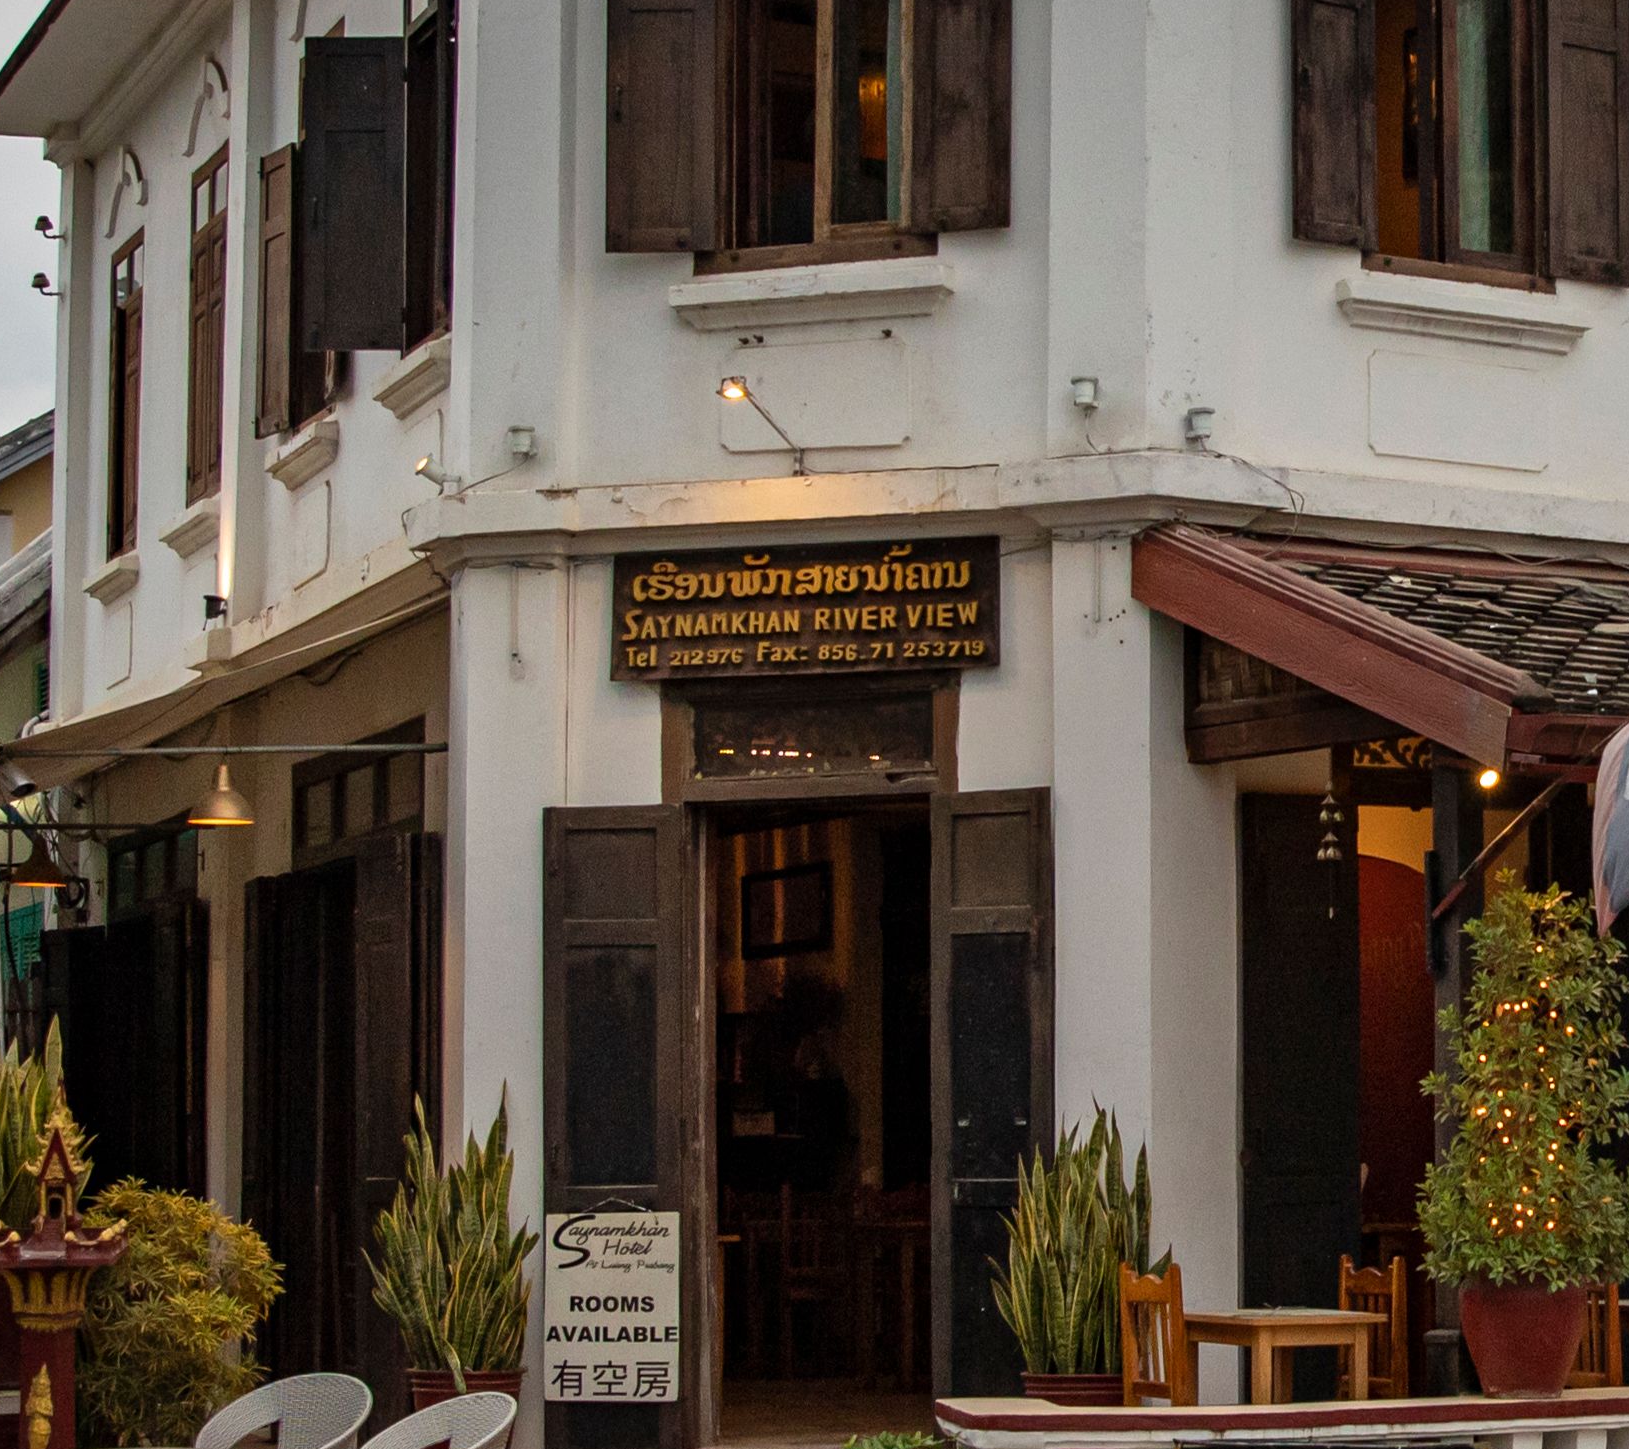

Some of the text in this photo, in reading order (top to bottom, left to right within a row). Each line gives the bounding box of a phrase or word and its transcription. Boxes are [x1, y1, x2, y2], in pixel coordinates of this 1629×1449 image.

[621, 601, 979, 642] SAYNAMKHAN RIVER VIEW
[626, 645, 658, 667] Tel
[670, 647, 744, 666] 212976
[903, 639, 986, 658] 253719
[569, 1295, 655, 1313] ROOMS
[546, 1325, 678, 1343] AVAILABLE
[551, 1359, 671, 1398] 有空房
